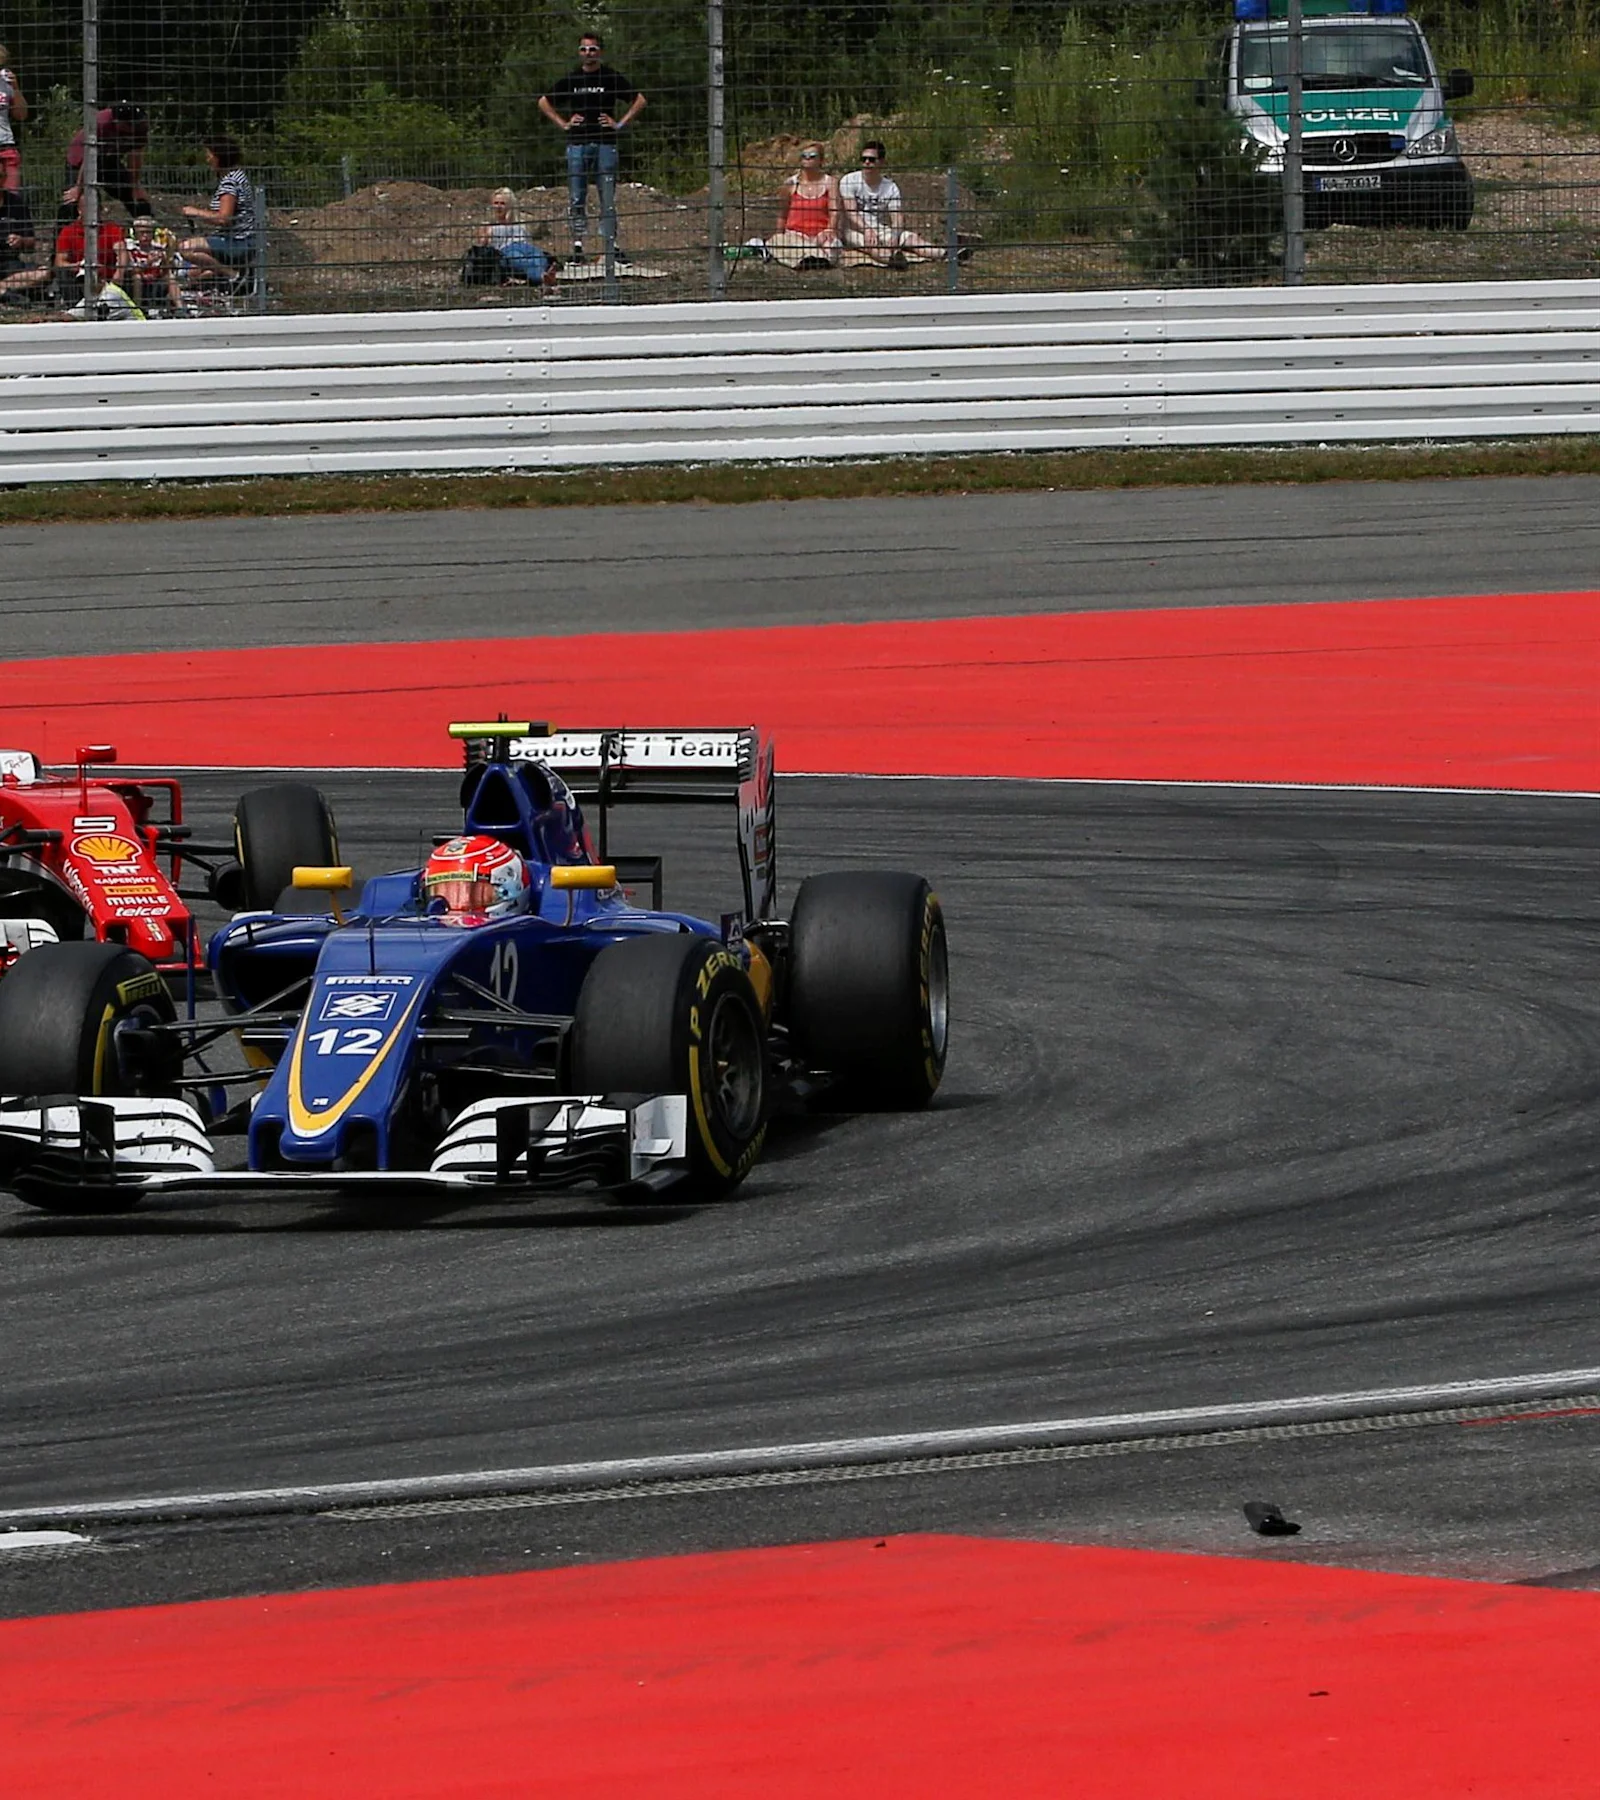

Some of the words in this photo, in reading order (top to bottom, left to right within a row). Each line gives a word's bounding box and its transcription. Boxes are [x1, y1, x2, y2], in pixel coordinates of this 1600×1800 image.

[1287, 108, 1399, 122] OLIZEI
[509, 737, 603, 758] Saube
[666, 736, 739, 758] Team
[73, 816, 116, 833] 5
[92, 865, 141, 875] TNT
[106, 895, 169, 905] MAHLE
[115, 905, 171, 917] telcel
[325, 976, 414, 985] PIRELLI
[308, 1028, 383, 1055] 12
